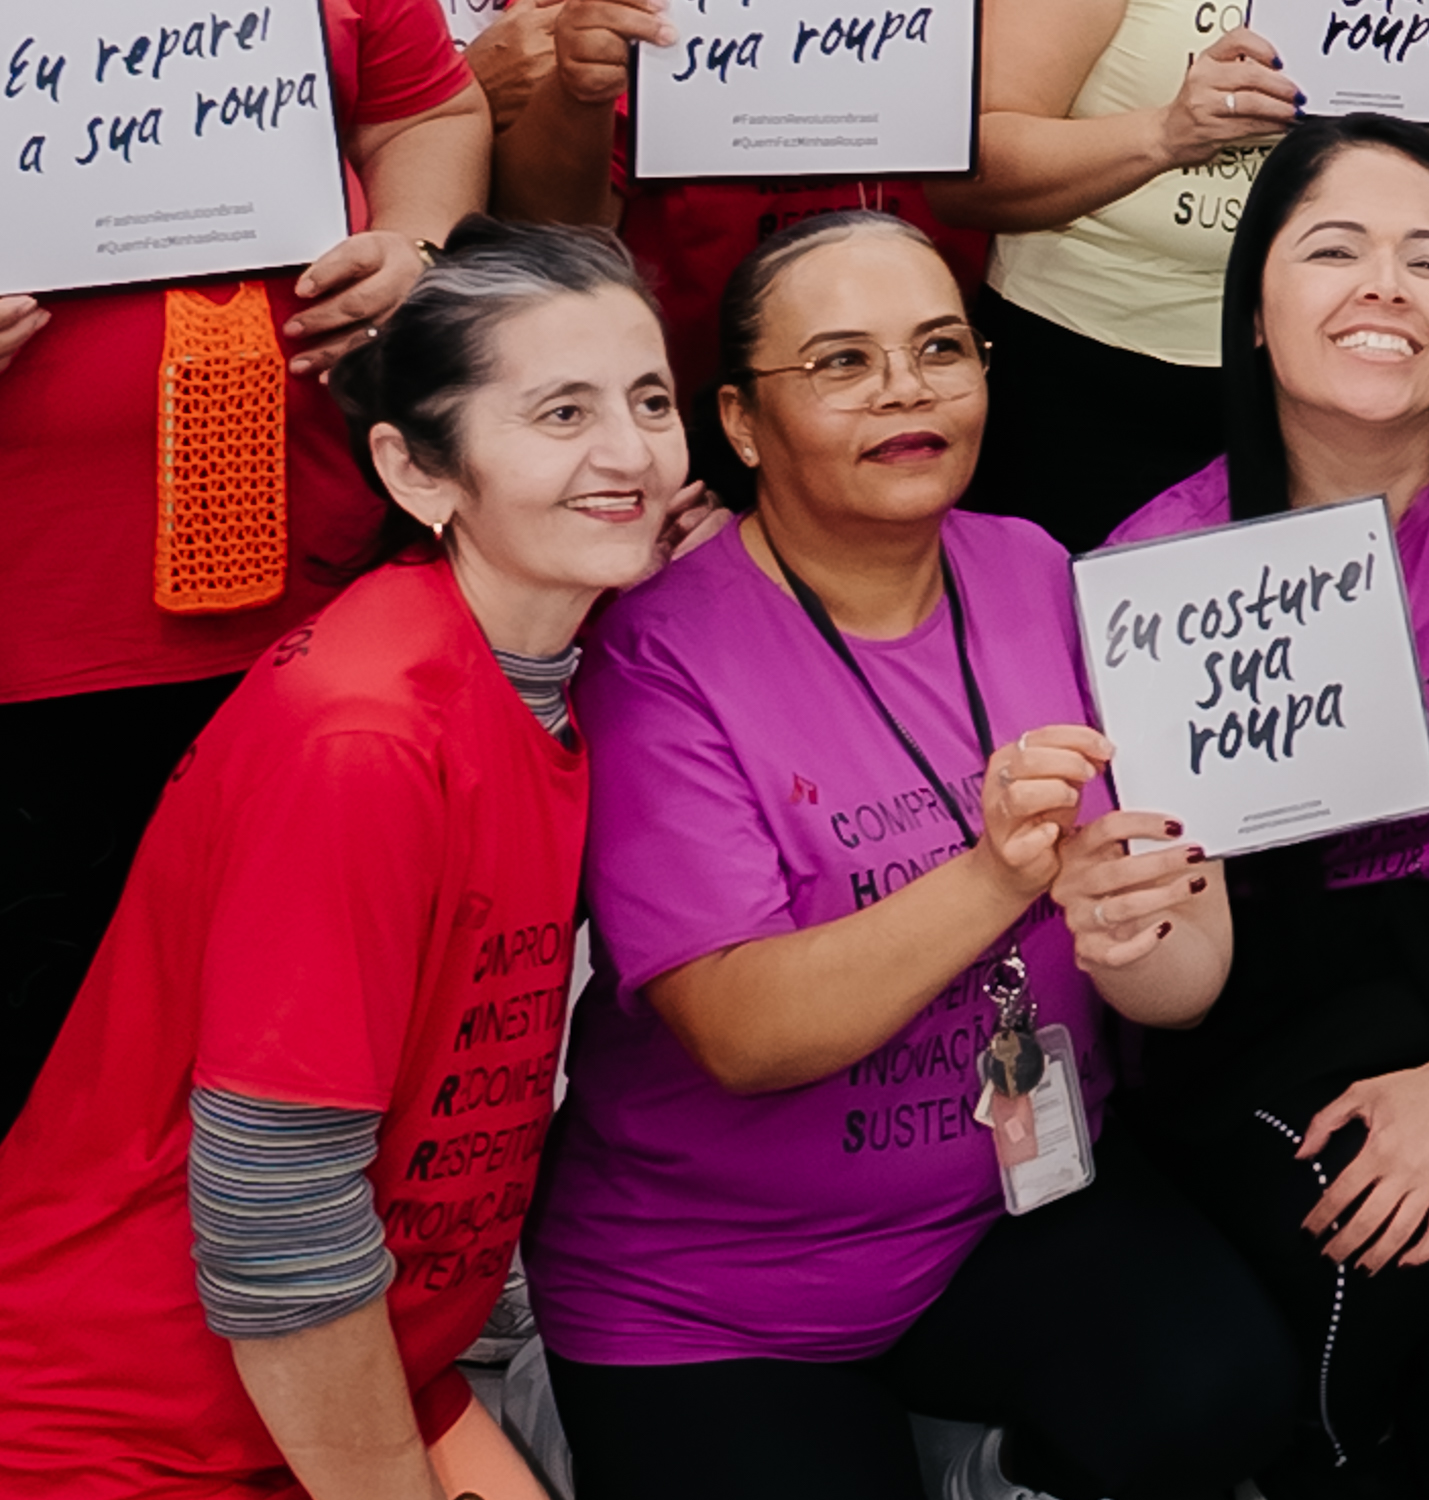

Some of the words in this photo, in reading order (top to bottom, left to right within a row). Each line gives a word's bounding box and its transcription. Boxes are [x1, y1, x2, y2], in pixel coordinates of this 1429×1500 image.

[4, 37, 67, 104] Eu
[671, 32, 764, 83] sua
[792, 7, 933, 64] roupa
[19, 135, 46, 174] a
[75, 107, 163, 166] sua
[194, 73, 319, 137] roupa
[1105, 599, 1161, 669] Eu
[1176, 530, 1379, 646] costurei
[1195, 636, 1297, 709] sua
[1188, 681, 1347, 776] roupa
